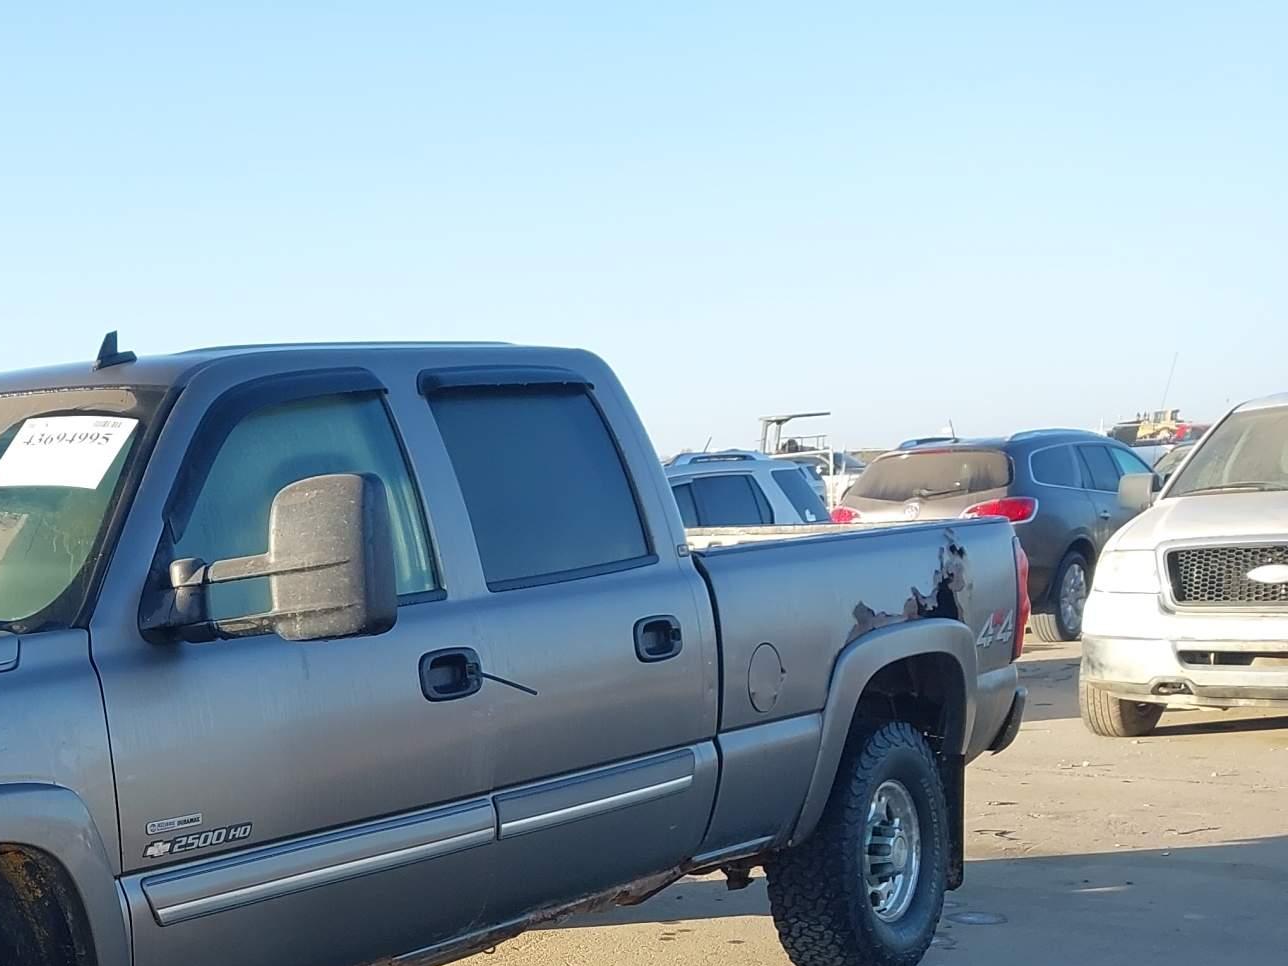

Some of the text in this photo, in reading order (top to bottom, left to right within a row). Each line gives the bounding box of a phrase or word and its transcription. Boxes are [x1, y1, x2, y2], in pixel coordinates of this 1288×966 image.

[23, 431, 113, 446] 43694995
[172, 824, 251, 853] 2500 HD
